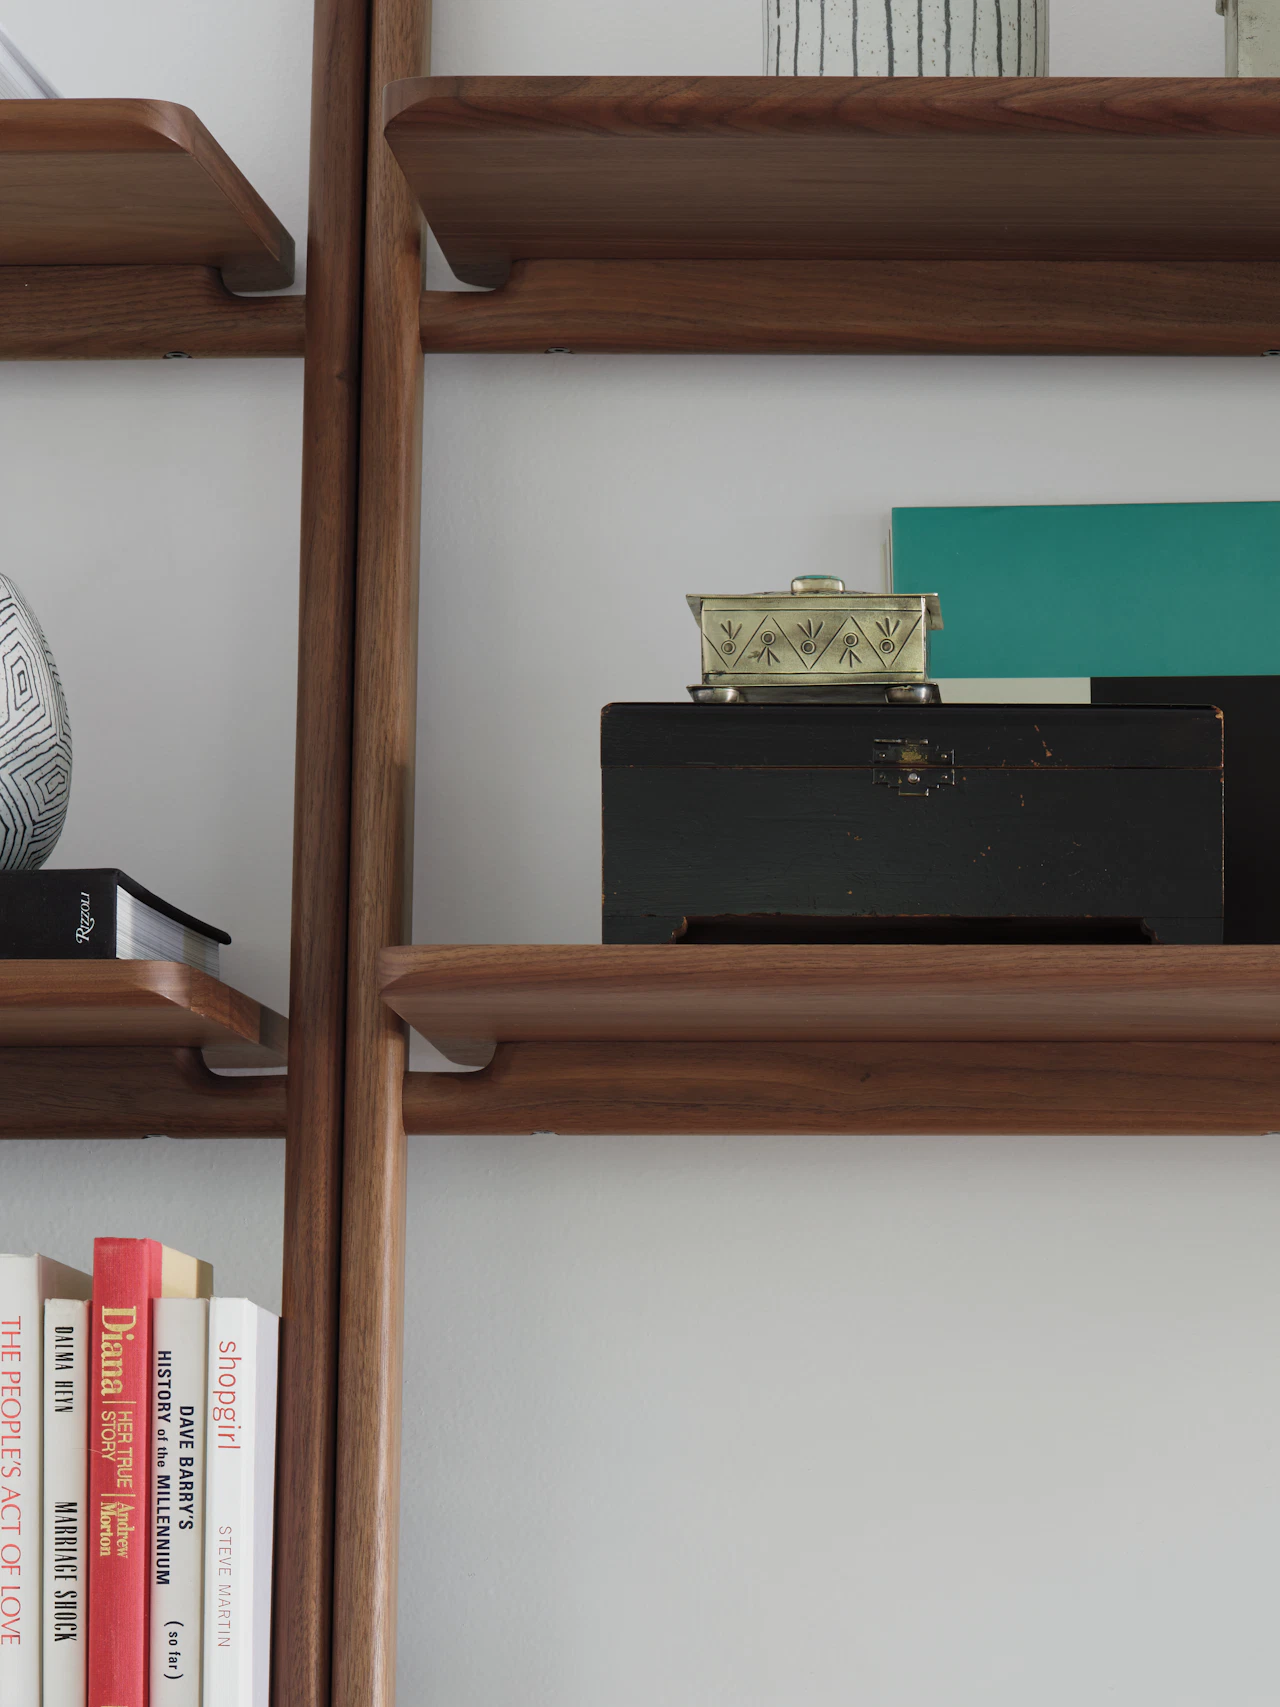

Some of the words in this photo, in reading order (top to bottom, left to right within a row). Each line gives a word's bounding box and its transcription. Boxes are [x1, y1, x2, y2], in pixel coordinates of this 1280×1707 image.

[76, 892, 95, 944] RIZZOLI
[1, 1315, 21, 1362] THE
[54, 1326, 74, 1371] DALMA
[100, 1305, 137, 1397] Diana
[54, 1380, 74, 1413] HEYN
[157, 1350, 172, 1423] HISTORY
[212, 1340, 242, 1449] shopgirl
[0, 1371, 22, 1478] PEOPLE'S
[100, 1410, 117, 1462] STORY
[117, 1410, 133, 1444] HER
[157, 1429, 169, 1442] of
[179, 1405, 195, 1449] DAVE
[116, 1447, 133, 1489] TRUE
[157, 1447, 169, 1468] the
[0, 1485, 22, 1536] ACT
[178, 1456, 194, 1530] BARRY'S
[54, 1501, 78, 1582] MARRIAGE
[99, 1501, 117, 1557] Morton
[116, 1501, 136, 1559] Andrew
[156, 1474, 171, 1585] MILLENNIUM
[218, 1526, 233, 1577] STEVE
[0, 1543, 22, 1576] OF
[0, 1586, 21, 1645] LOVE
[54, 1590, 78, 1642] SHOCK
[217, 1584, 231, 1648] MARTIN
